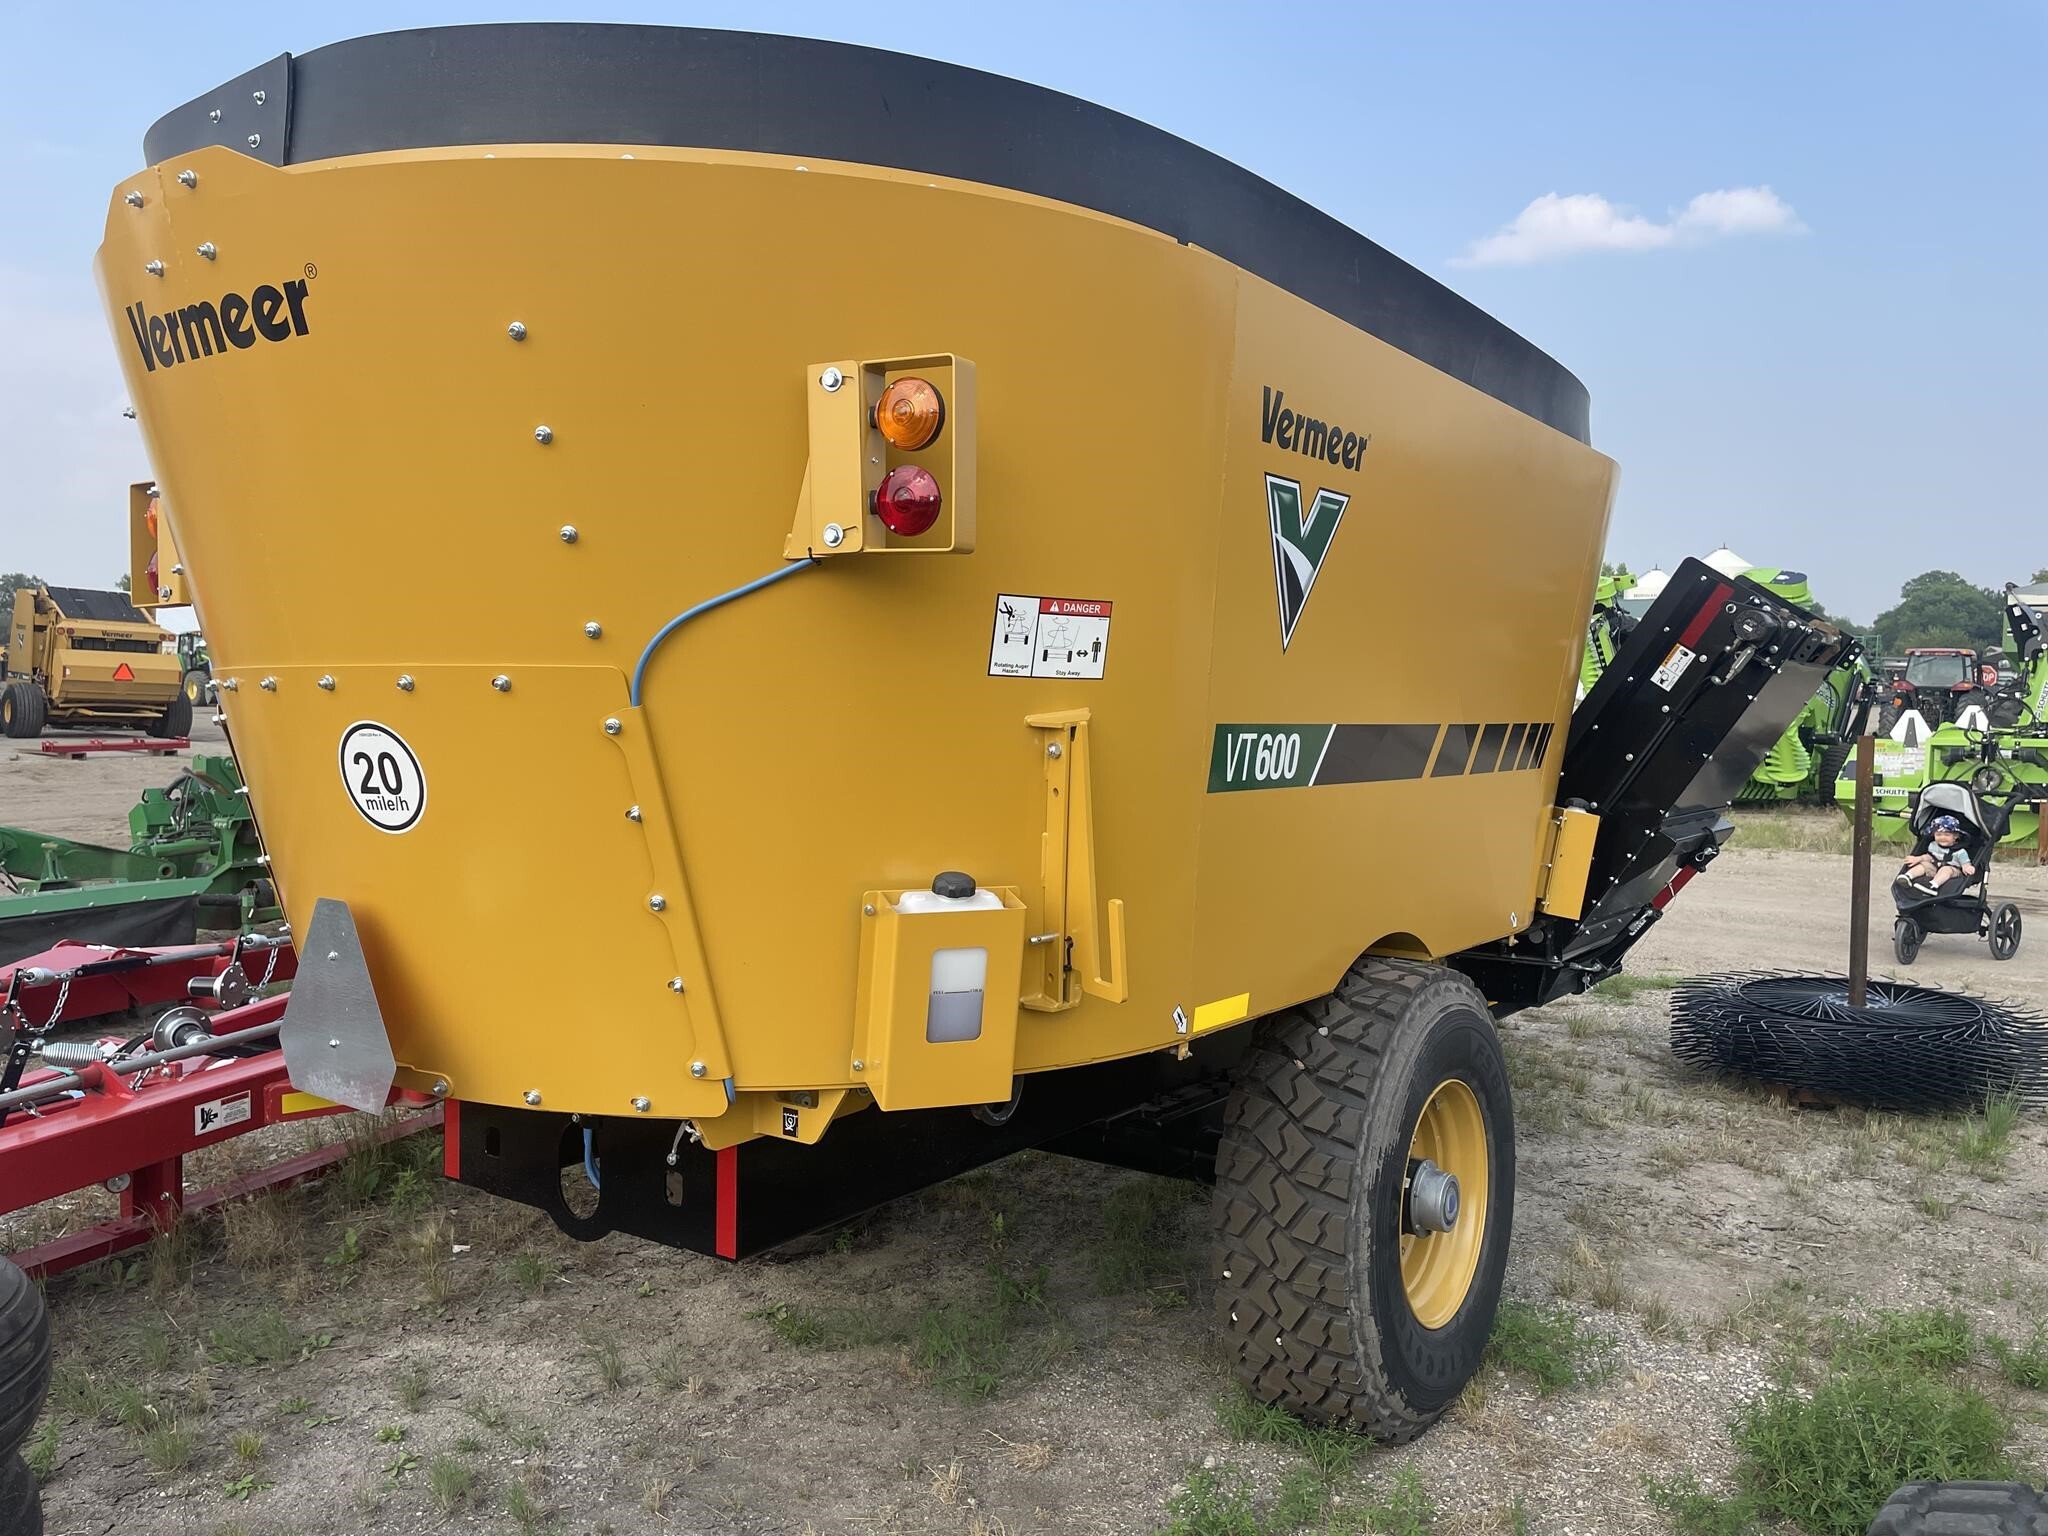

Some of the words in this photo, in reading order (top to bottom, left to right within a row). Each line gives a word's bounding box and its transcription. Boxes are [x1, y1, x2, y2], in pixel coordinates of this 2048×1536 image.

[125, 278, 310, 372] Vermeer
[1261, 385, 1368, 472] Vermeer
[1063, 602, 1101, 614] DANGER
[101, 630, 133, 638] Vermeer
[353, 751, 403, 796] 20
[1226, 733, 1301, 782] VT600
[365, 795, 410, 812] mile/h
